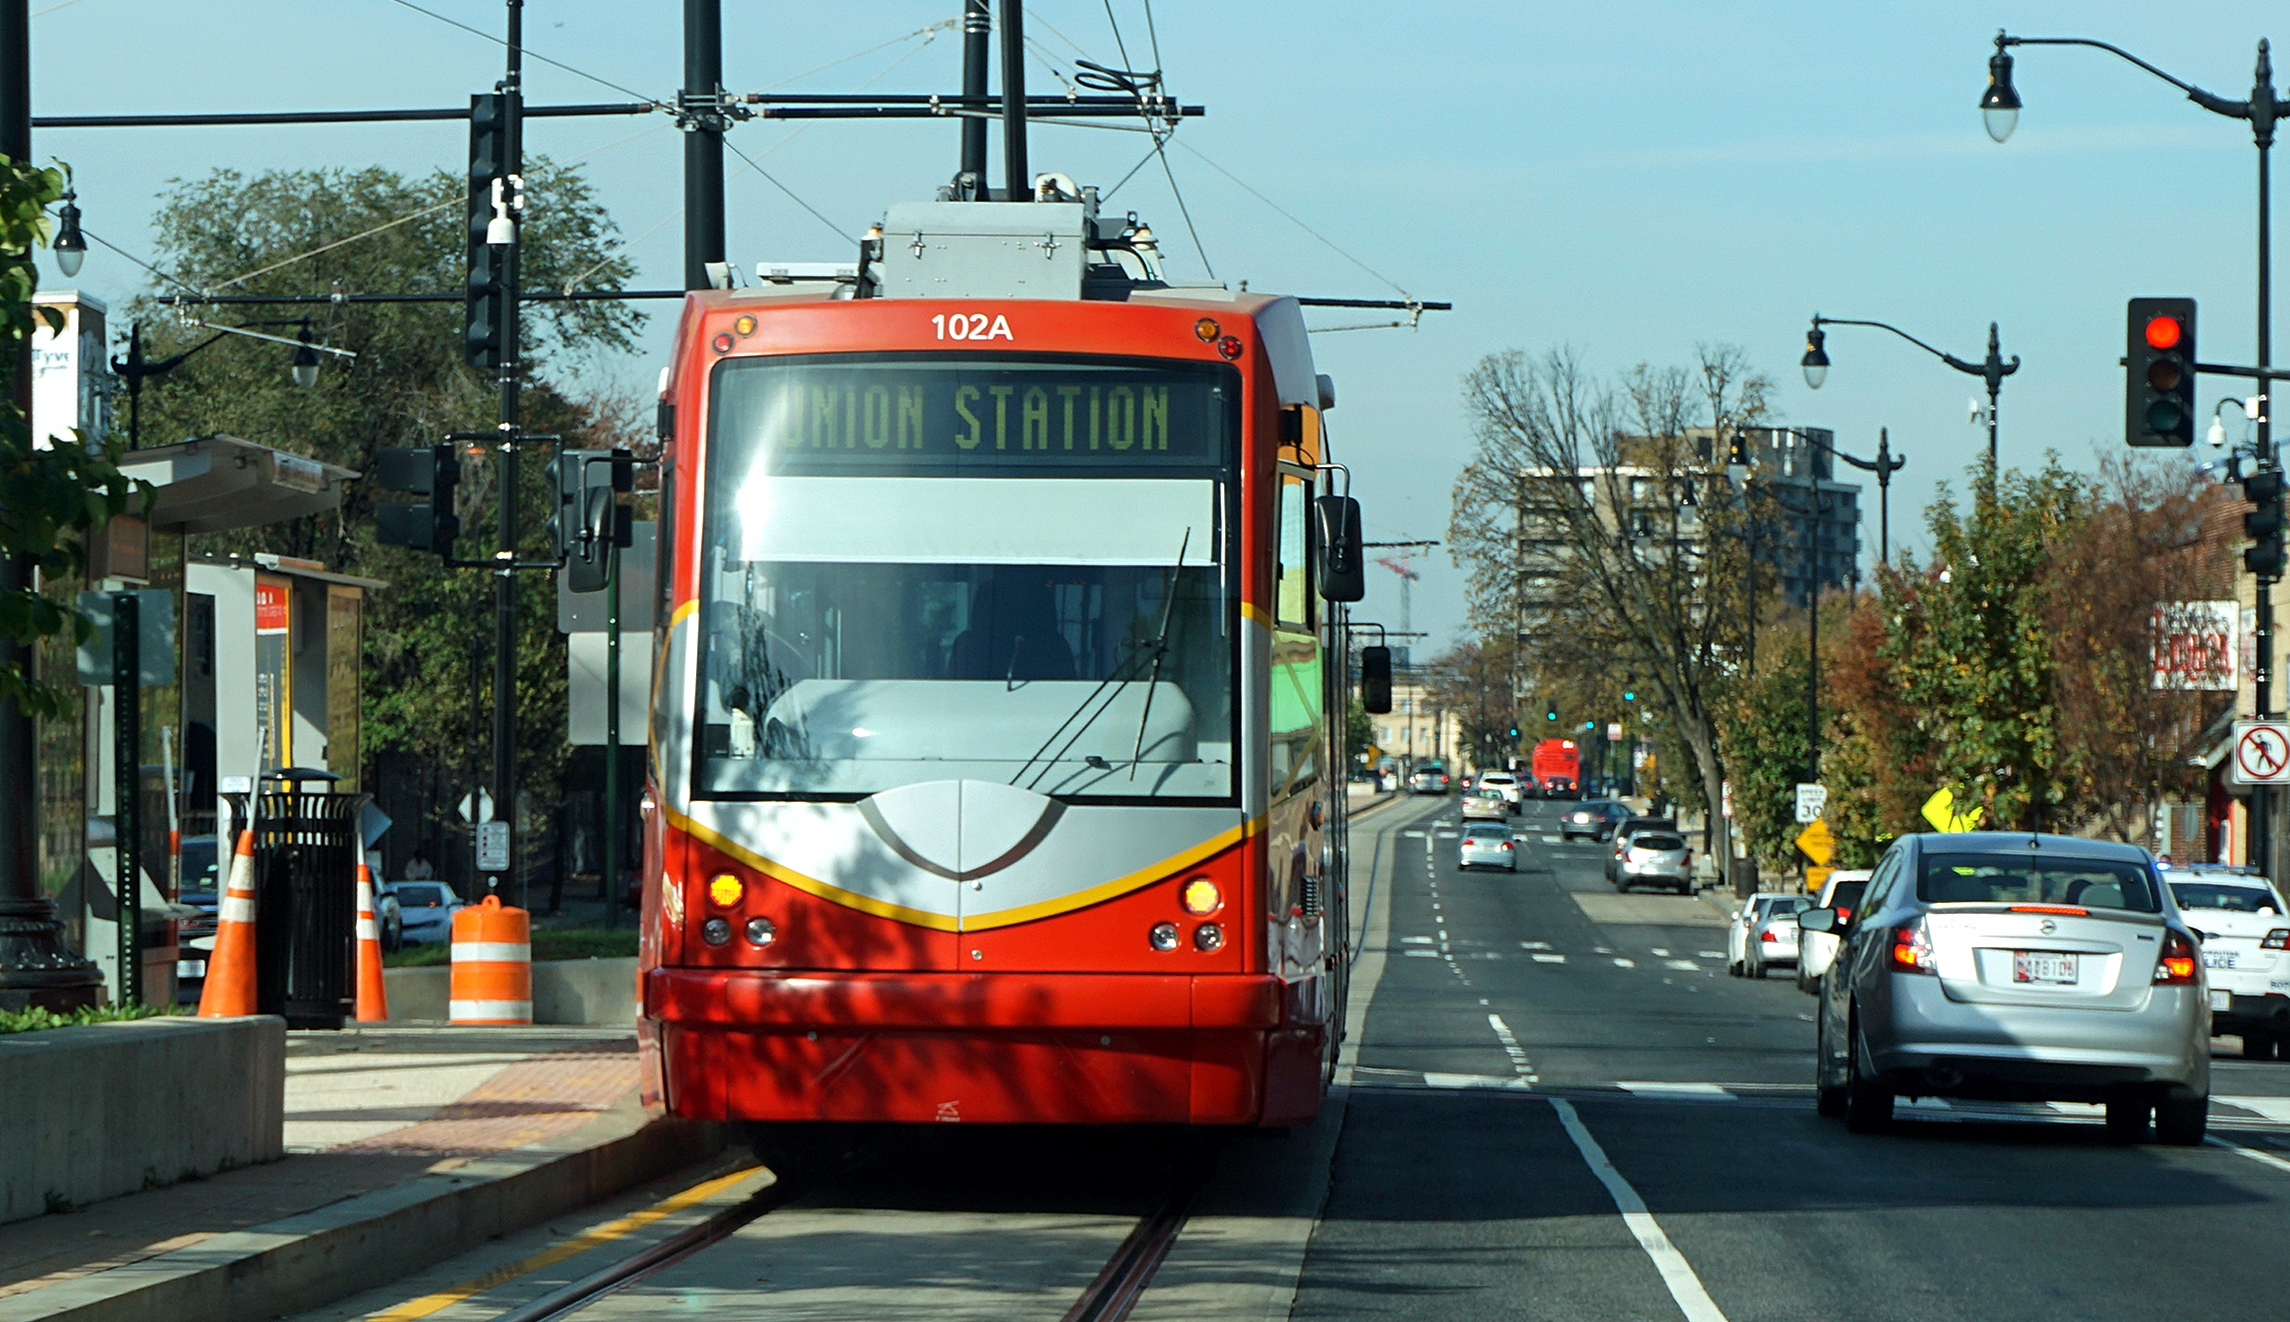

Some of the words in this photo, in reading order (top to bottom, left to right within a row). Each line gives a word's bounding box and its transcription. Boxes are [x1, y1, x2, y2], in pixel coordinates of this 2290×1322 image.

[931, 313, 1014, 341] 102A
[778, 384, 923, 449] UNION
[955, 385, 1168, 450] STATION
[1801, 804, 1823, 818] 30
